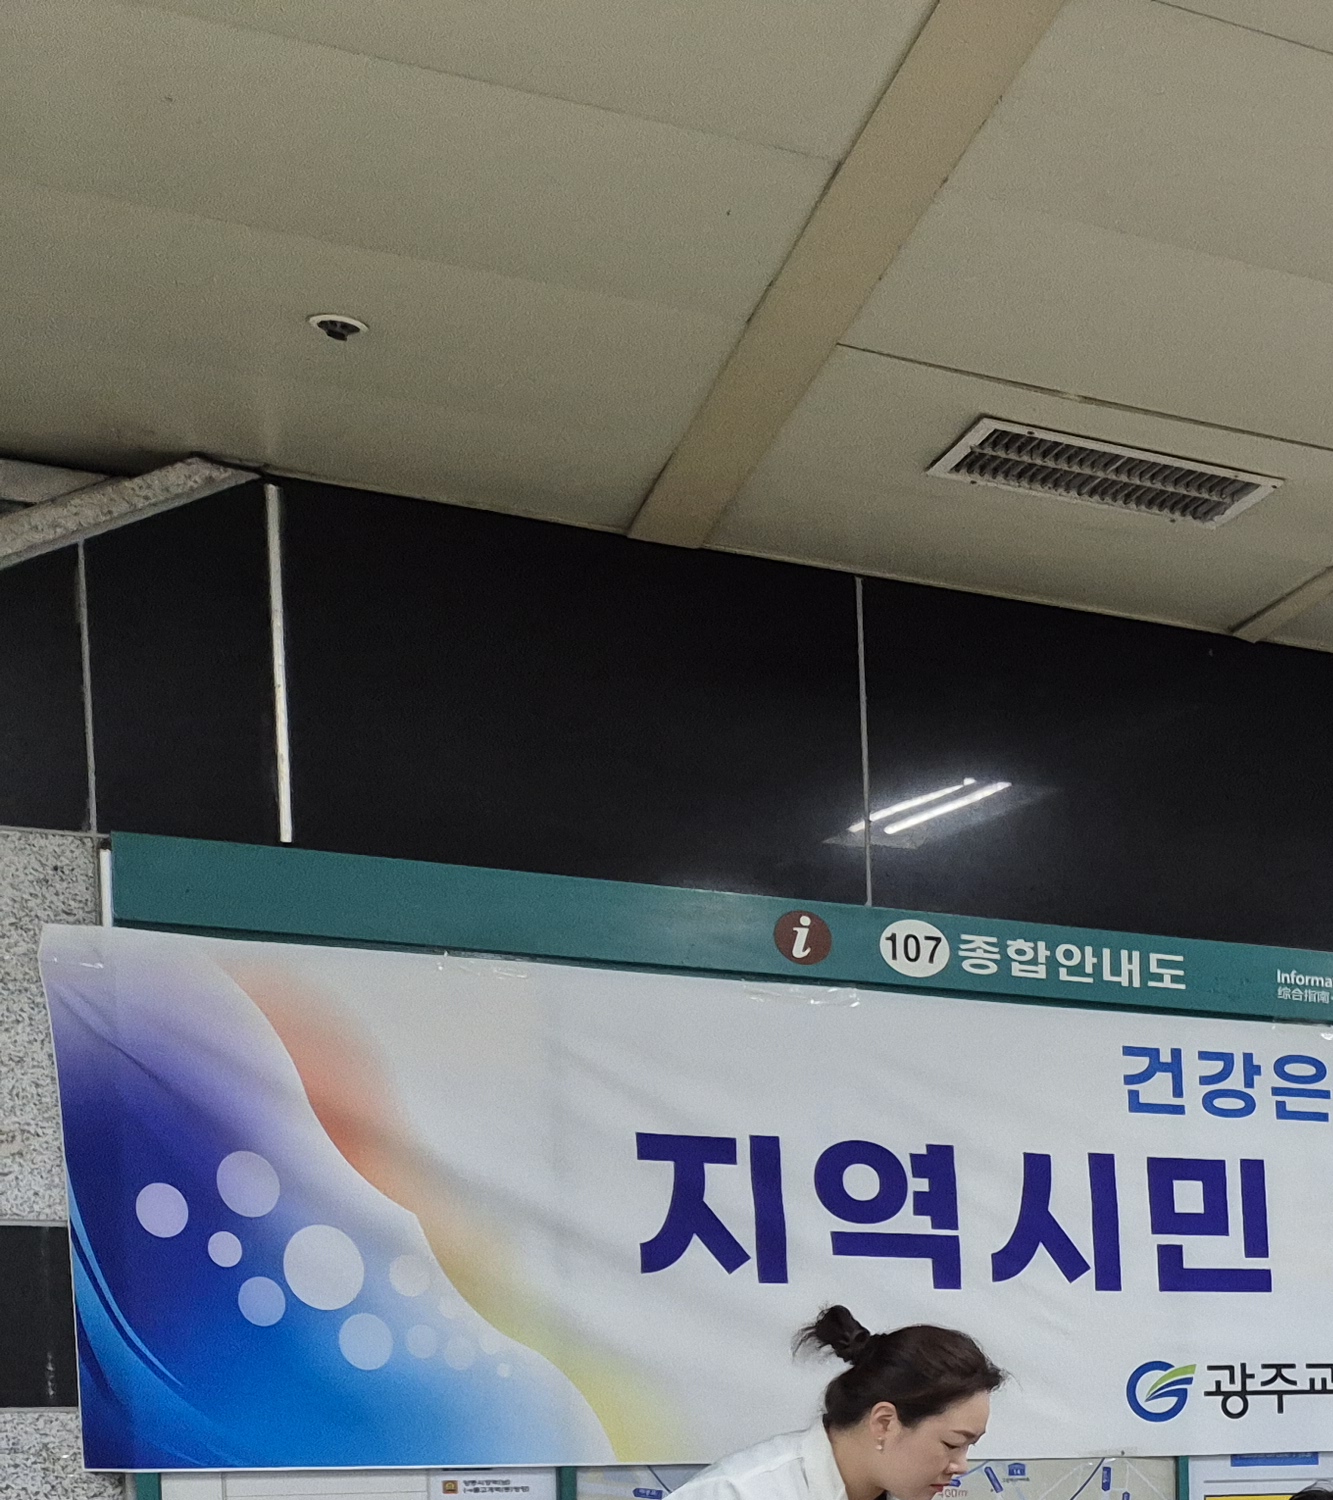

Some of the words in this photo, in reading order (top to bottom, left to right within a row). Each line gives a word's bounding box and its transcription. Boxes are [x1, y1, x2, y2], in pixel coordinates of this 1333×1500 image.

[884, 931, 943, 966] 107
[958, 932, 1186, 990] 종합안내도
[1122, 1045, 1331, 1123] 건강은
[636, 1132, 1273, 1292] 지역시민
